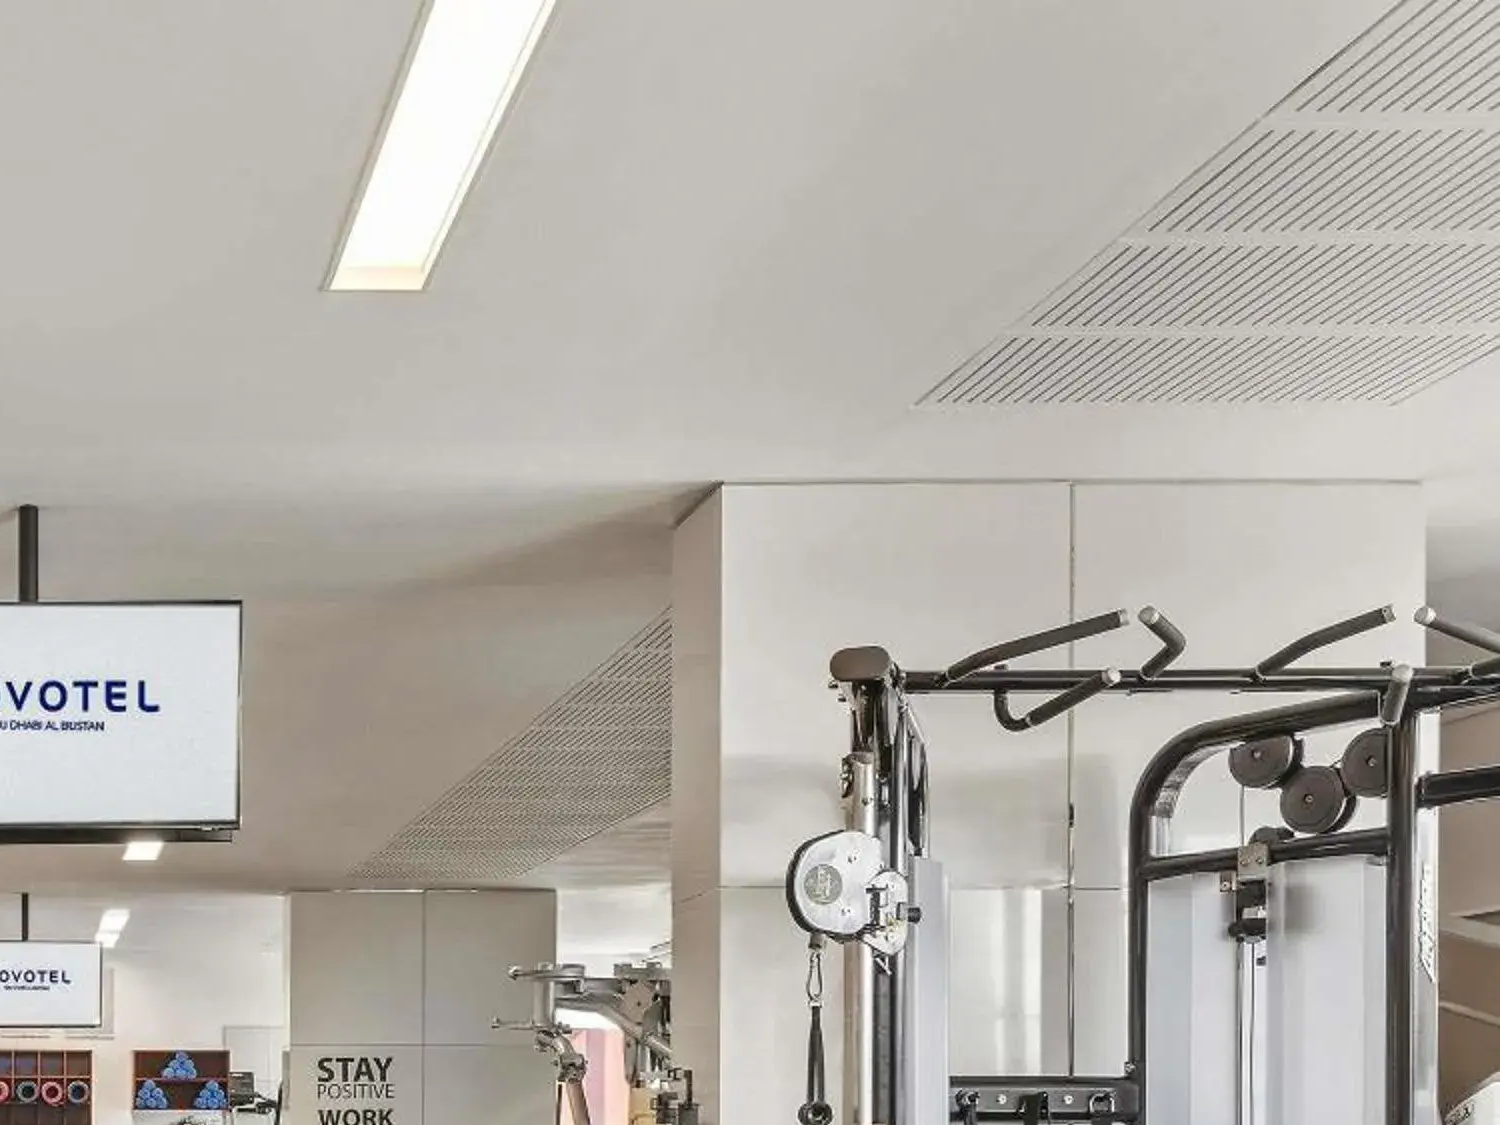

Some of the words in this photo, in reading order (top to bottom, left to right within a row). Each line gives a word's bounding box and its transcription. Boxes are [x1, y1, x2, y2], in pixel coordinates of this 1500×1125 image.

[9, 719, 42, 731] DHABI
[44, 720, 59, 731] AL
[61, 720, 105, 731] BUSTAN
[317, 1057, 393, 1083] STAY
[317, 1083, 396, 1099] POSITIVE
